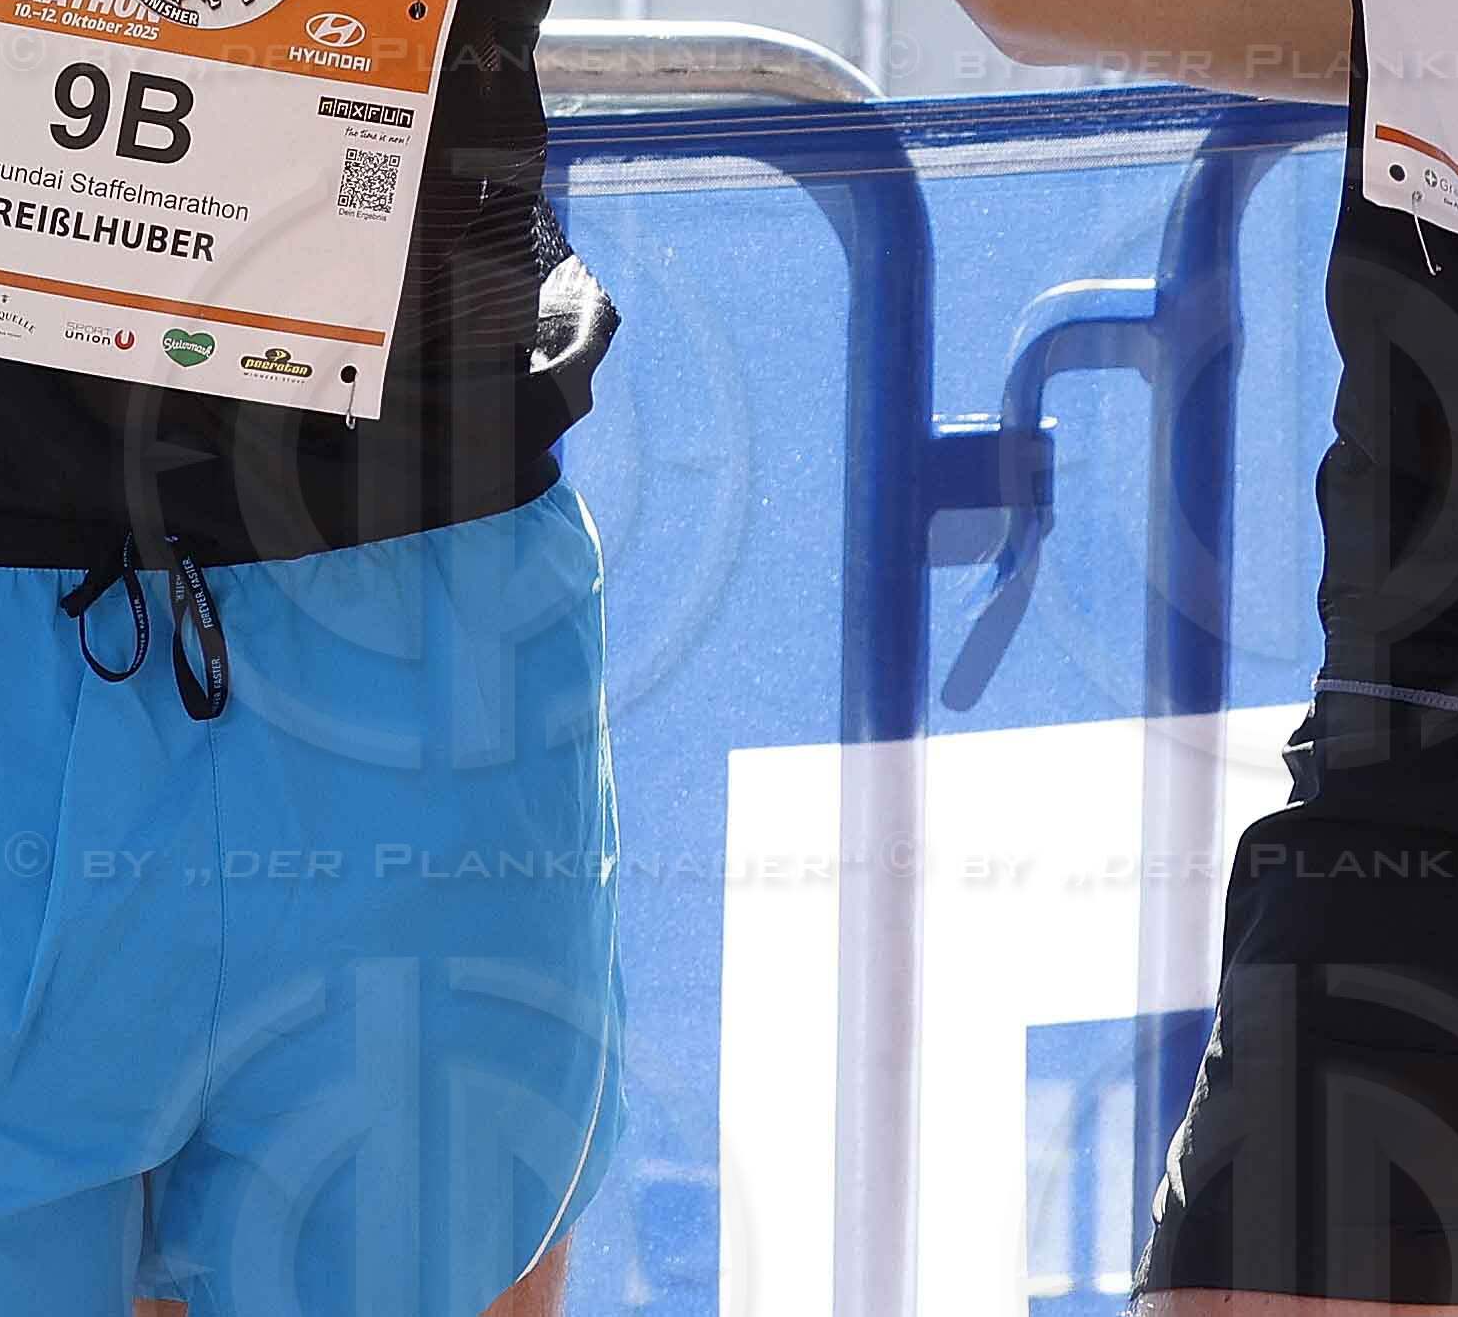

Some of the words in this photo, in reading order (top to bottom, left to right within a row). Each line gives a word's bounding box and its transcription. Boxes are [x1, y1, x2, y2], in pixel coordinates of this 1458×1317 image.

[61, 12, 123, 36] Oktober
[123, 23, 160, 41] 2025
[289, 46, 372, 72] HYUNDAI
[49, 62, 194, 164] 9B
[70, 172, 250, 222] Staffelmarathon
[64, 330, 111, 346] union
